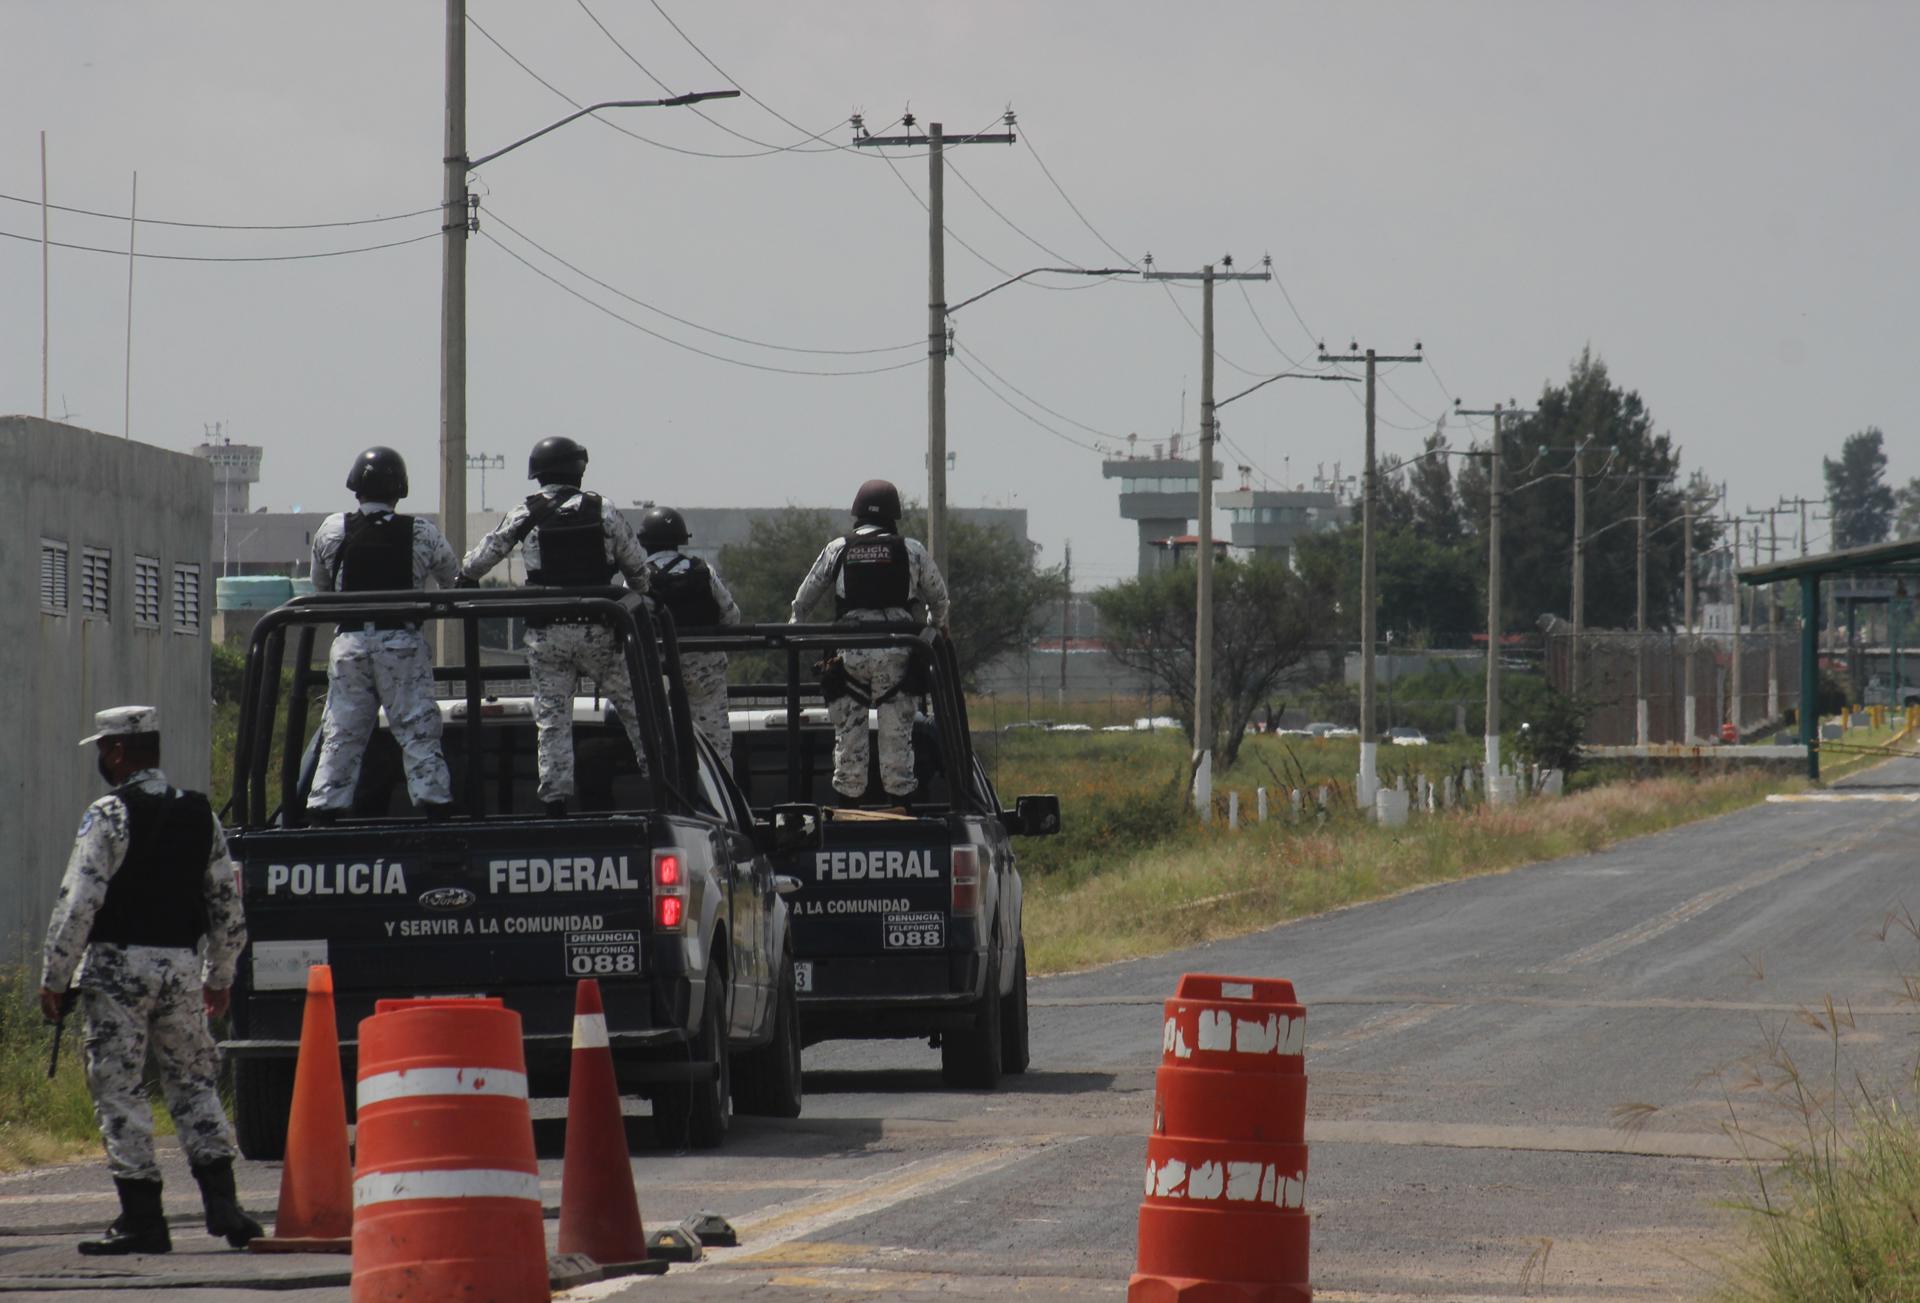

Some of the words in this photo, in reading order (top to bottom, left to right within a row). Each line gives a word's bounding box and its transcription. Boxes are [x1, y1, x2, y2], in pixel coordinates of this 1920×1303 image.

[848, 545, 890, 553] POLICÍA
[816, 849, 939, 880] FEDERAL
[267, 859, 407, 896] POLICÍA
[489, 856, 638, 894] FEDERAL
[794, 903, 802, 914] A
[806, 902, 823, 914] LA
[827, 898, 910, 913] COMUNIDAD
[887, 913, 940, 922] DENUNCIA
[385, 922, 396, 937] Y
[400, 919, 459, 935] SERVIR
[463, 919, 476, 934] A
[479, 918, 500, 934] LA
[504, 915, 604, 932] COMUNIDAD
[571, 932, 634, 943] DENUNCIA
[888, 931, 940, 946] 088
[572, 954, 635, 974] 088
